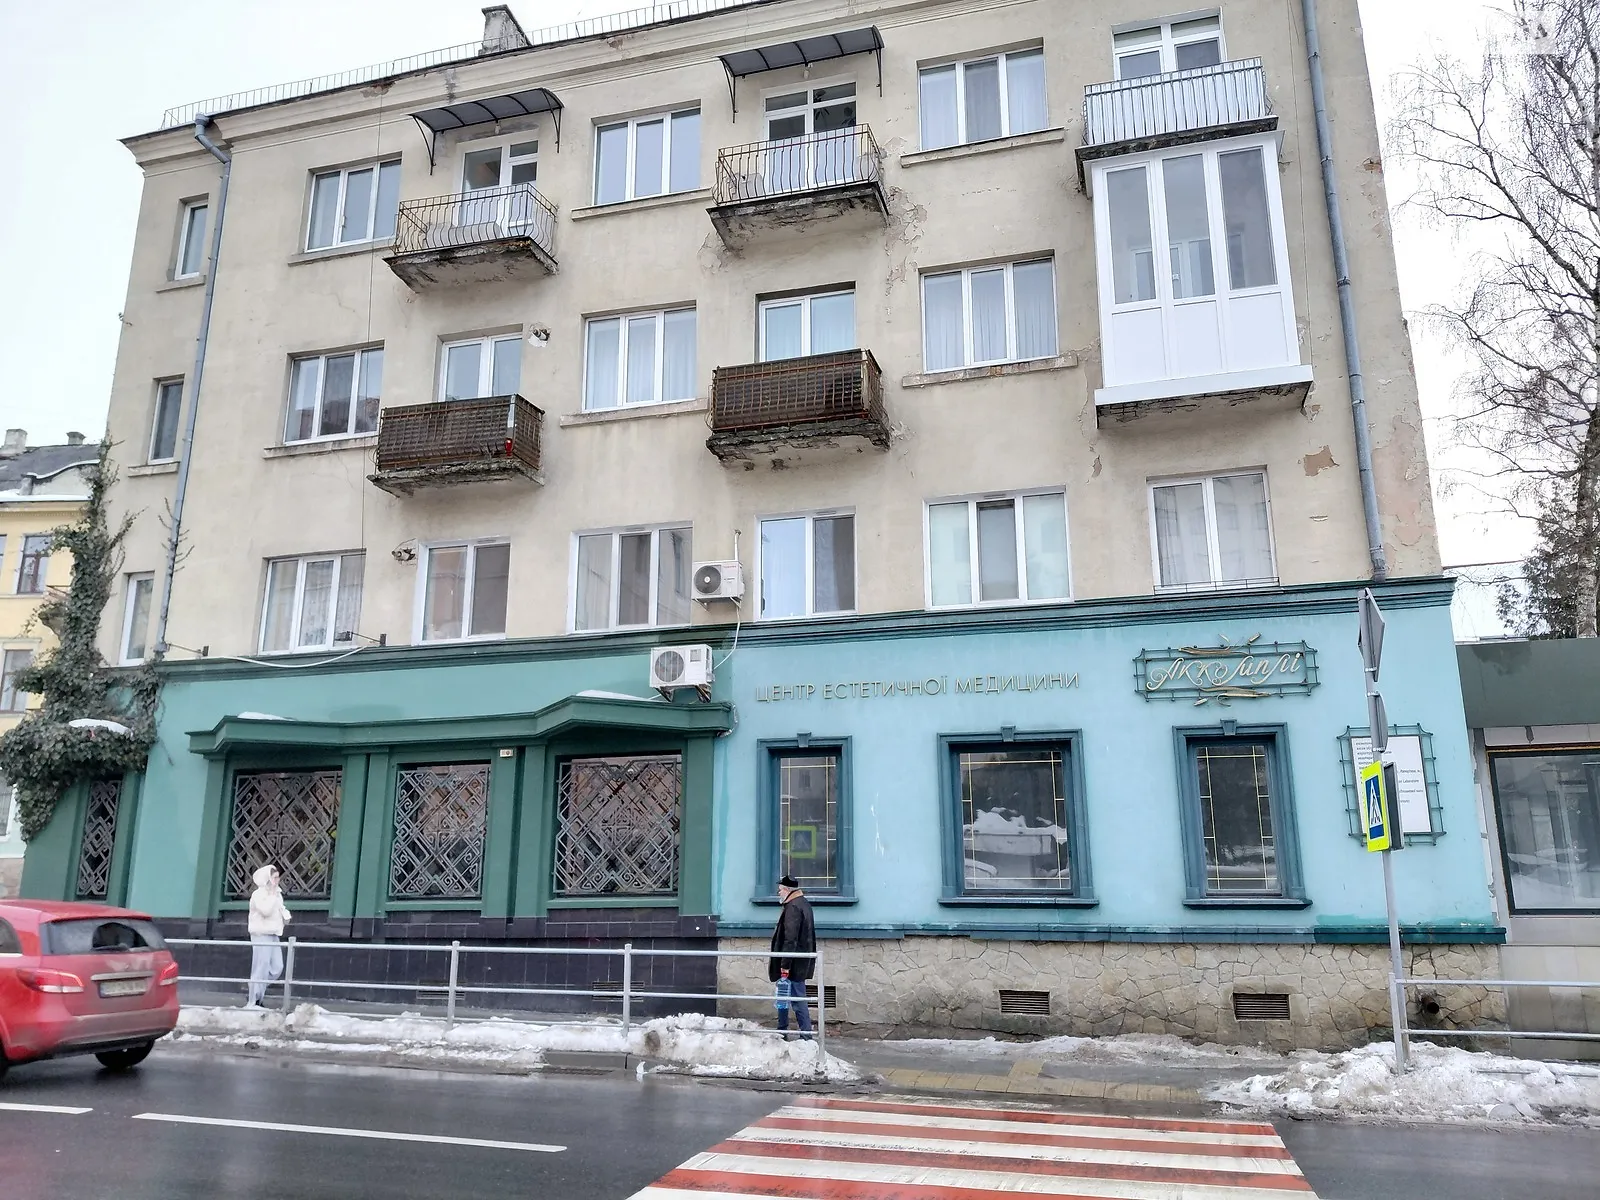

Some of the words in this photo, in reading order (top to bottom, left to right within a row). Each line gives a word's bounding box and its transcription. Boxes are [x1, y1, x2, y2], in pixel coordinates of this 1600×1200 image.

[755, 683, 816, 702] ЦЕНТР
[823, 676, 948, 699] ЕСТЕТИЧНОЇ
[954, 672, 1080, 694] МЕДИЦИНИ
